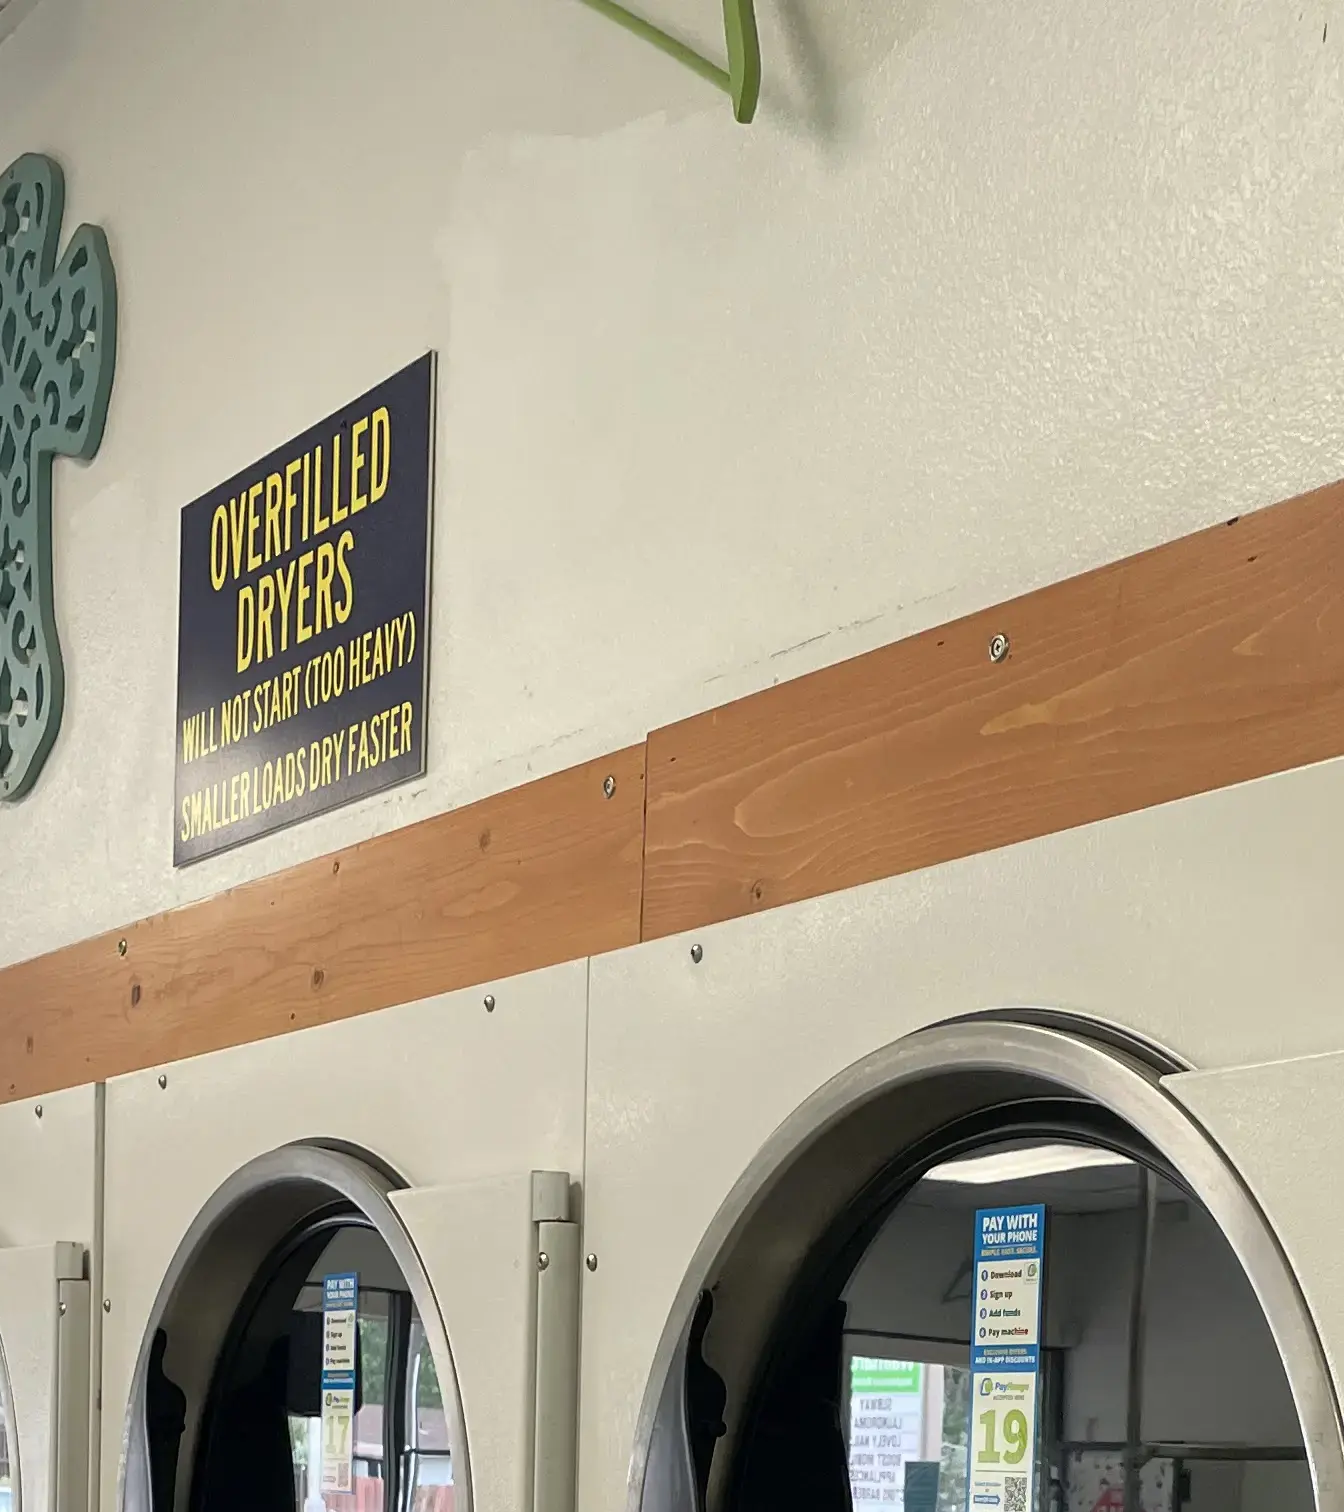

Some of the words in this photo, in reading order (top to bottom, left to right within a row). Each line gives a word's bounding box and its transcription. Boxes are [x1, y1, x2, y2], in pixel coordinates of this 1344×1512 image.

[208, 405, 391, 592] OVERFILLED
[236, 529, 356, 673] DRYERS
[182, 710, 218, 764] WILL
[221, 689, 250, 744] NOT
[252, 666, 304, 733] START
[304, 645, 344, 711] (TOO
[349, 611, 417, 692] HEAVY)
[180, 773, 249, 841] SMALLER
[253, 747, 306, 815] LOADS
[309, 729, 345, 791] DRY
[347, 702, 412, 778] FASTER
[982, 1216, 1005, 1232] PAY
[1007, 1213, 1038, 1229] WITH
[982, 1232, 1006, 1244] YOUR
[1008, 1230, 1037, 1243] PHONE
[988, 1328, 1000, 1338] Pay
[326, 1415, 350, 1454] 17
[977, 1409, 1028, 1464] 19
